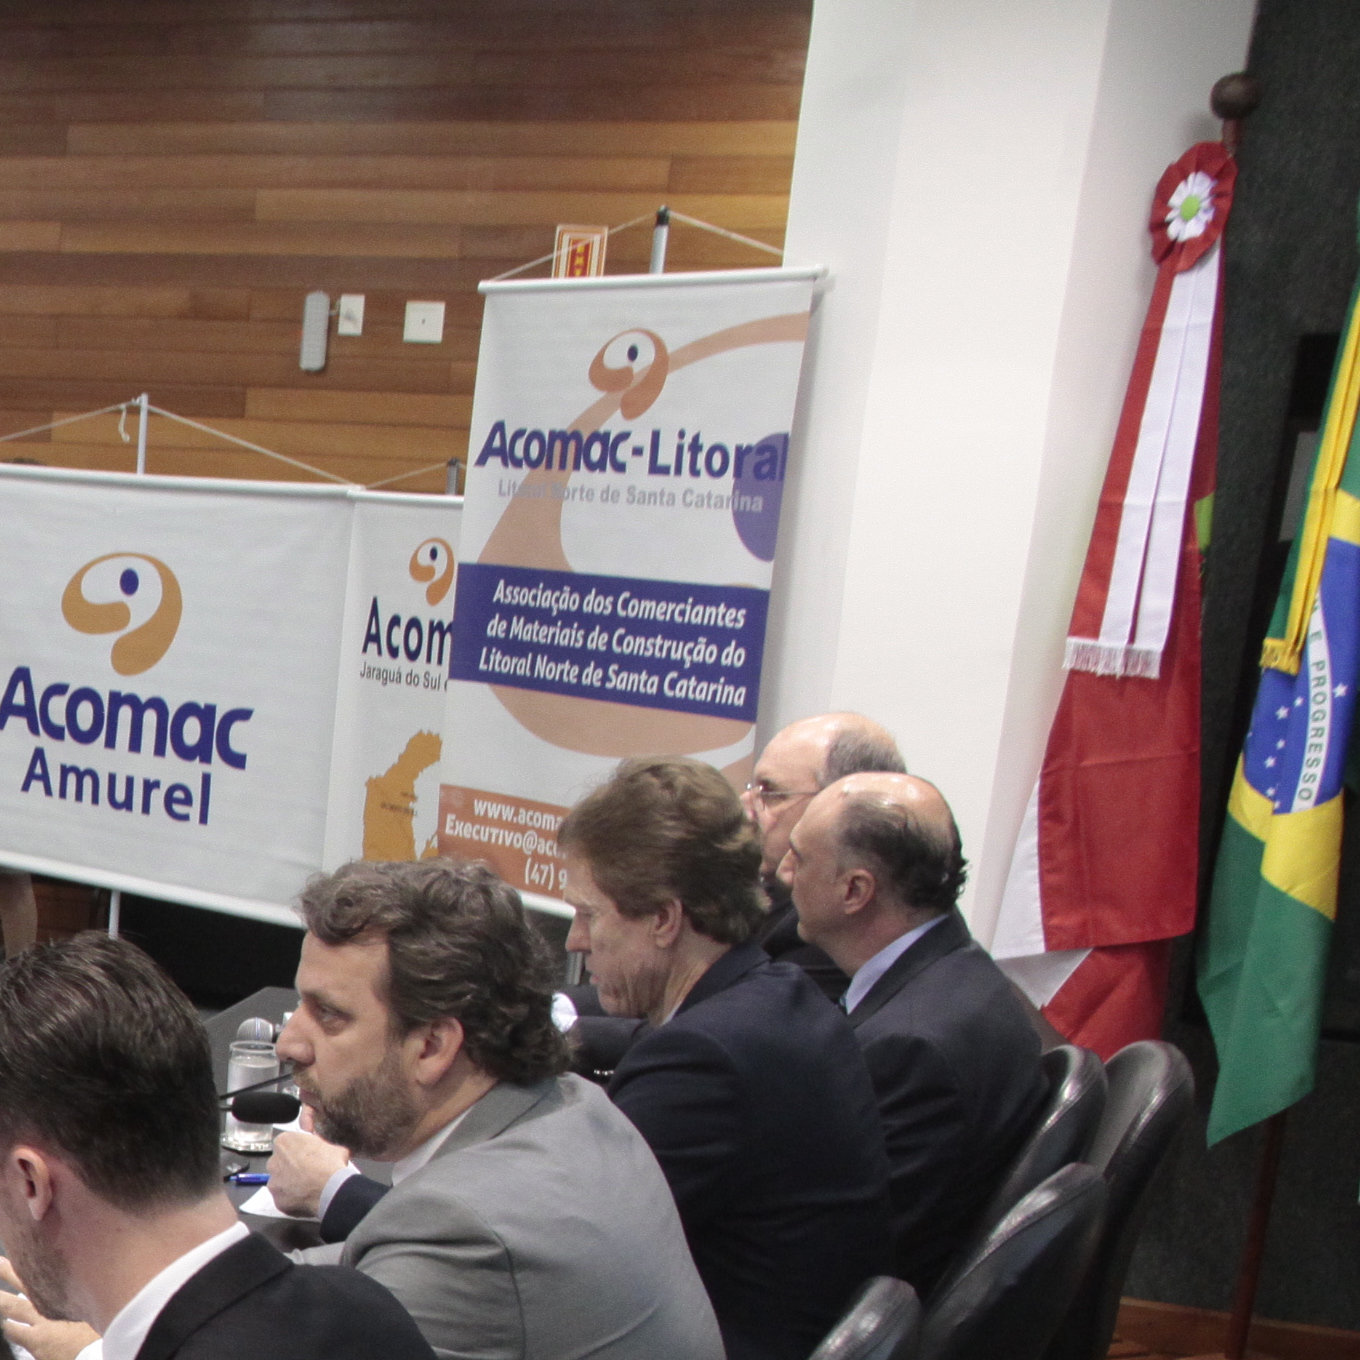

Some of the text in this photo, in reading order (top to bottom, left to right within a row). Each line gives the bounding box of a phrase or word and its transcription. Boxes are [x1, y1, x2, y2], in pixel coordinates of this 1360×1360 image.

[474, 420, 789, 481] Acomac-Litoral
[600, 484, 621, 503] de
[626, 485, 676, 507] Santa
[682, 488, 763, 513] Catarina
[492, 579, 746, 629] Associação dos Comerciantes
[487, 613, 746, 668] de Materiais de Construção do
[360, 661, 402, 686] Jaraguá
[405, 668, 420, 687] do
[423, 671, 441, 691] Sul
[479, 647, 747, 707] Litoral Norte de Santa Catarina
[1298, 659, 1328, 801] PROGRESSO
[21, 746, 212, 825] Amurel
[524, 857, 555, 891] (47)
